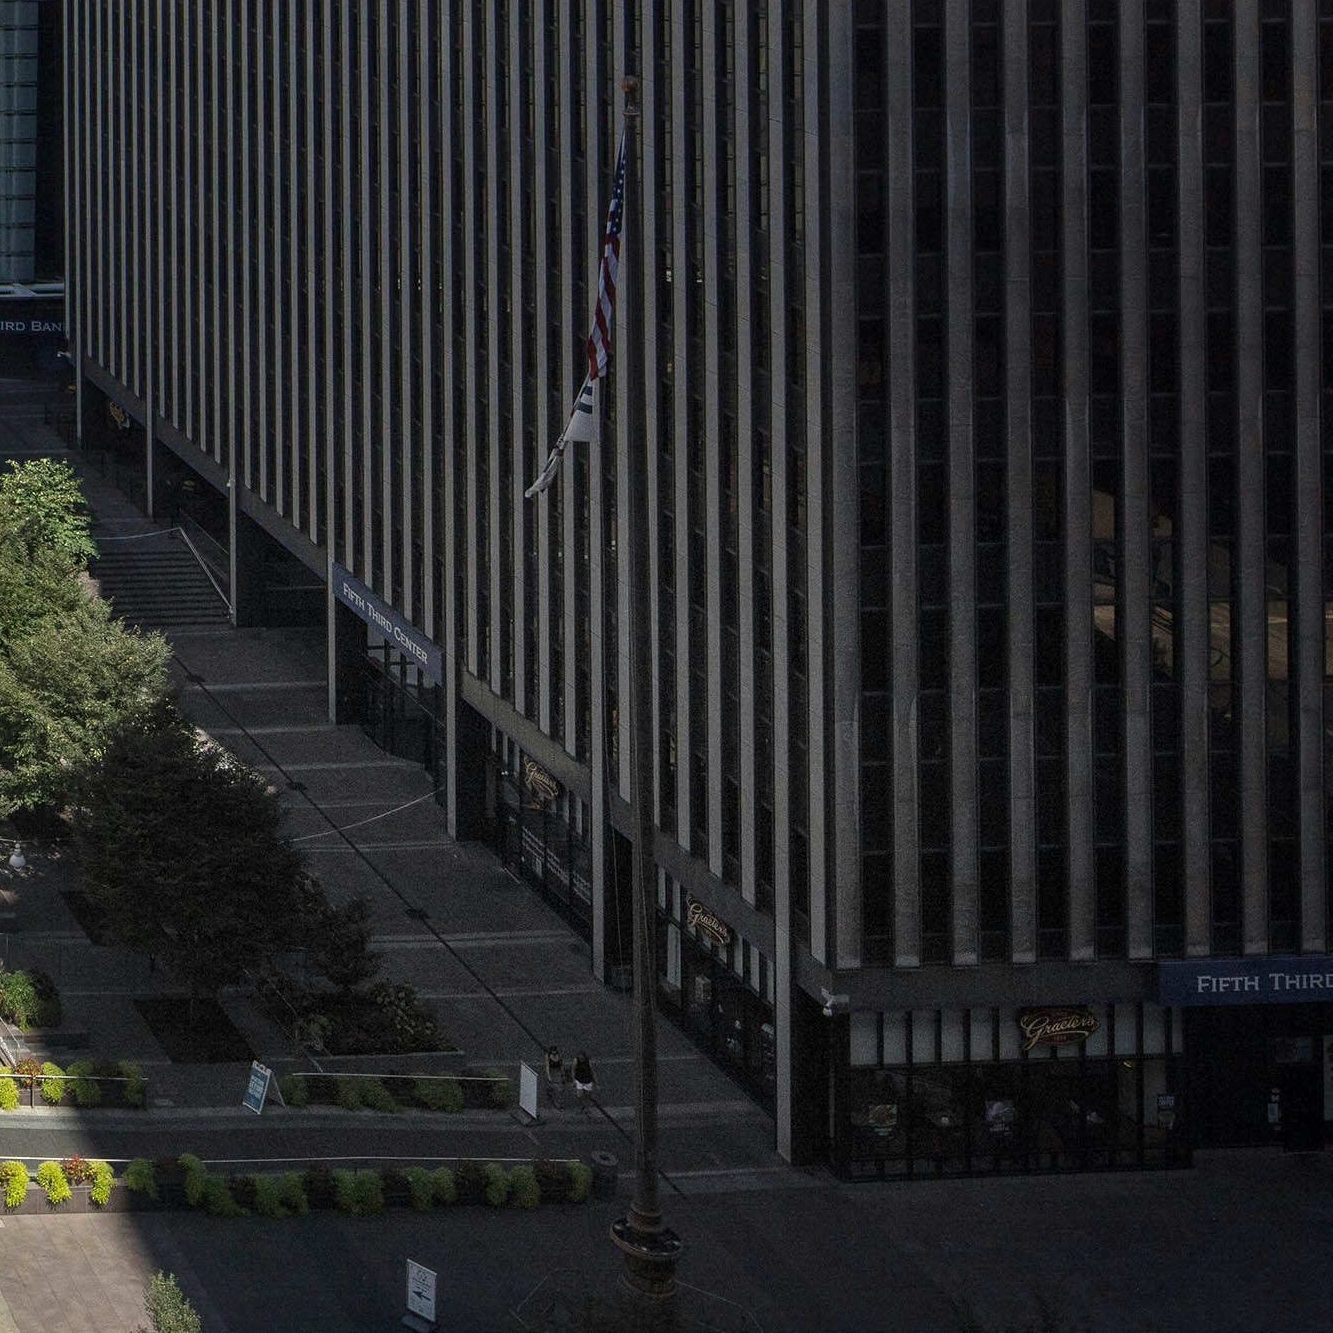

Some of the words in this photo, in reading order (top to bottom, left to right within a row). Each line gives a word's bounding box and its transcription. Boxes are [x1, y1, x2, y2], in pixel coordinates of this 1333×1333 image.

[30, 321, 64, 333] BAN
[343, 582, 365, 611] FIFTH
[367, 603, 392, 633] THIRD
[394, 626, 428, 664] CENTER
[1196, 975, 1260, 993] FIFTH
